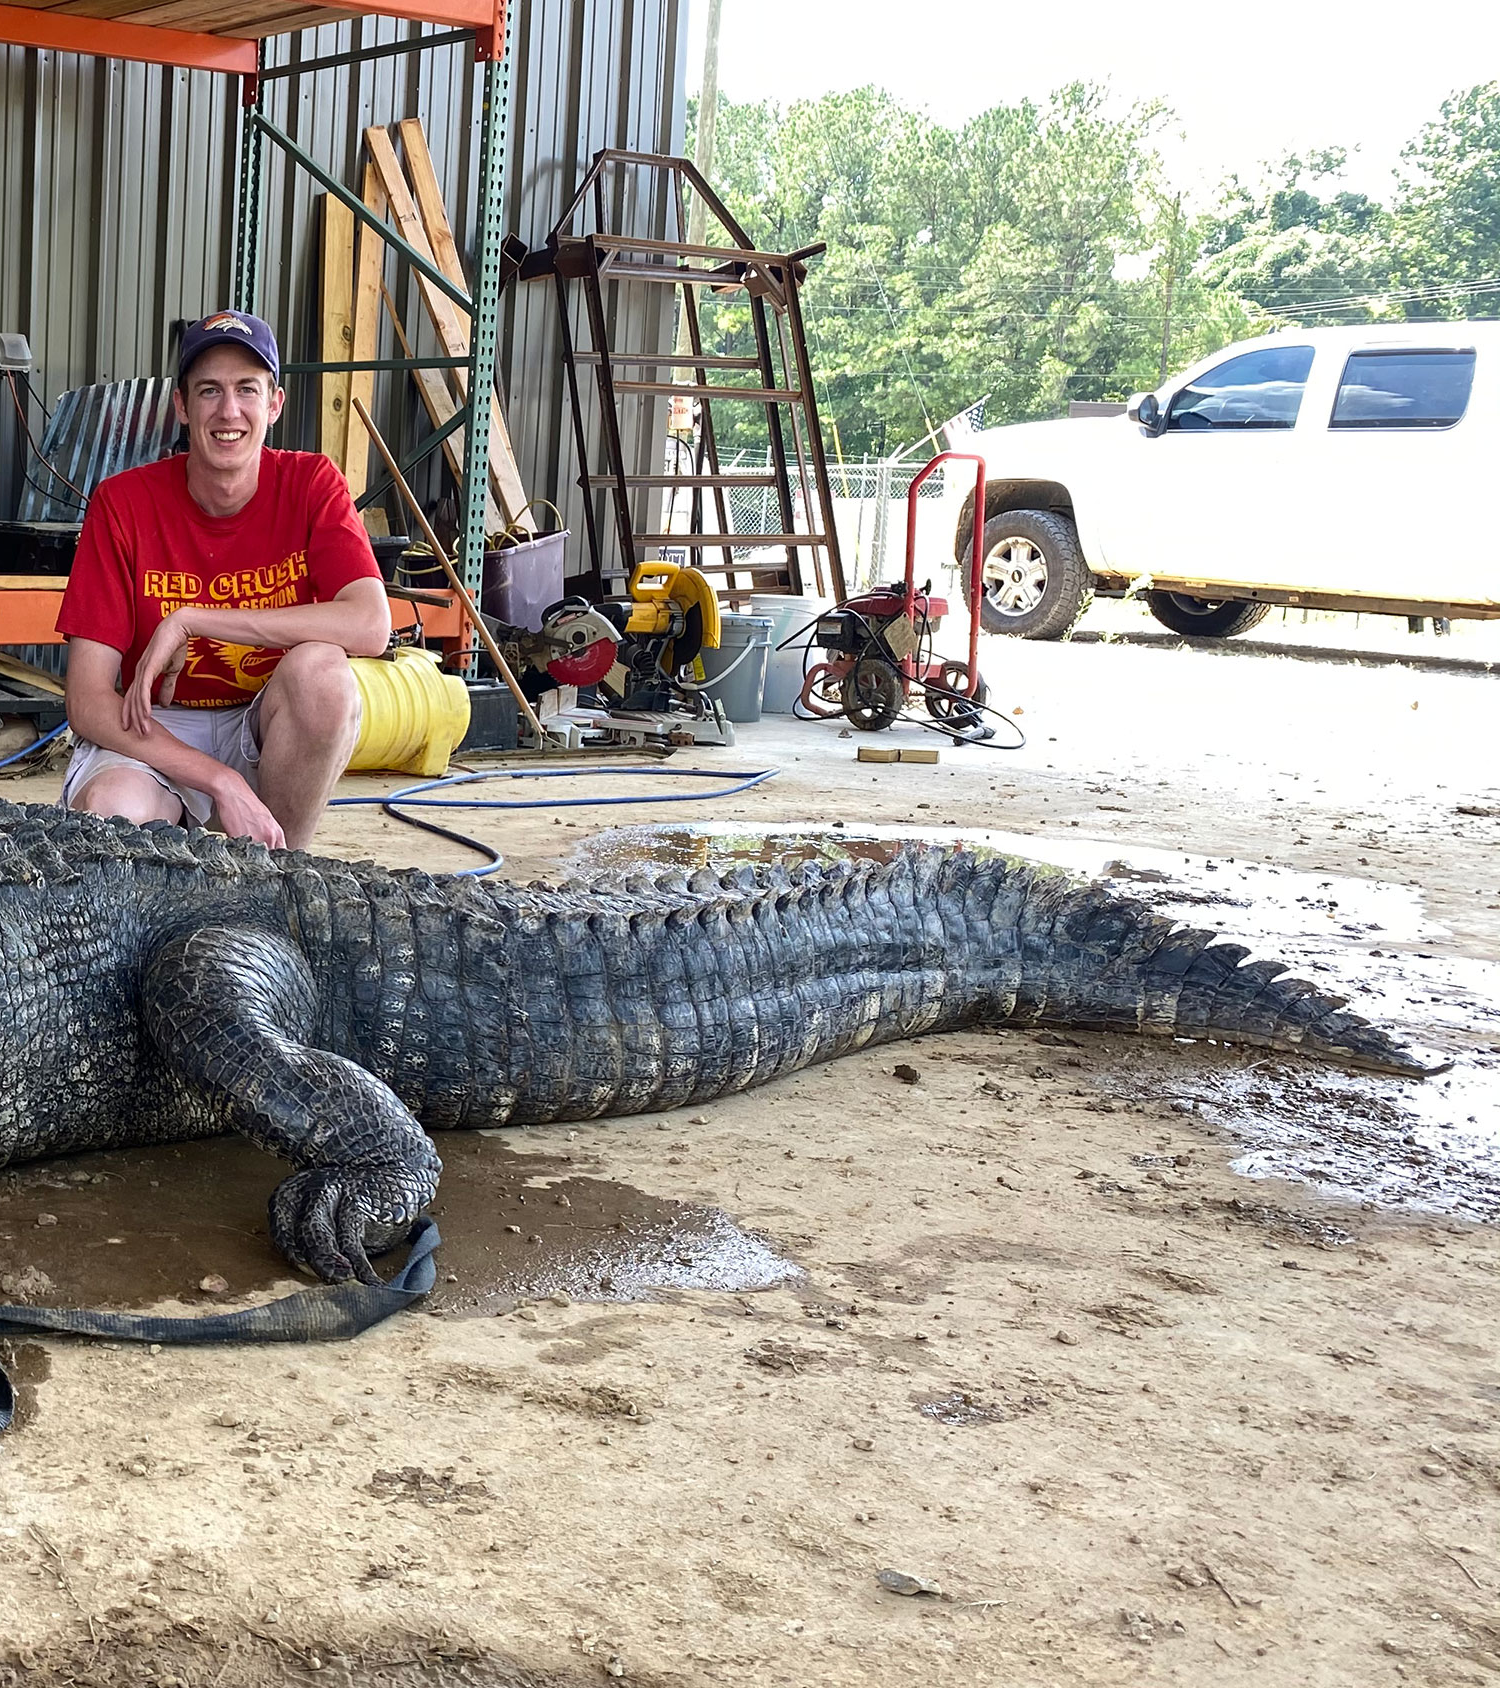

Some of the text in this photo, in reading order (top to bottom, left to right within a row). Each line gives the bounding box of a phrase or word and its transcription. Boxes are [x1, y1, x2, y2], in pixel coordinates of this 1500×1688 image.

[144, 550, 308, 600] RED CRUSH
[239, 584, 298, 610] SECTION
